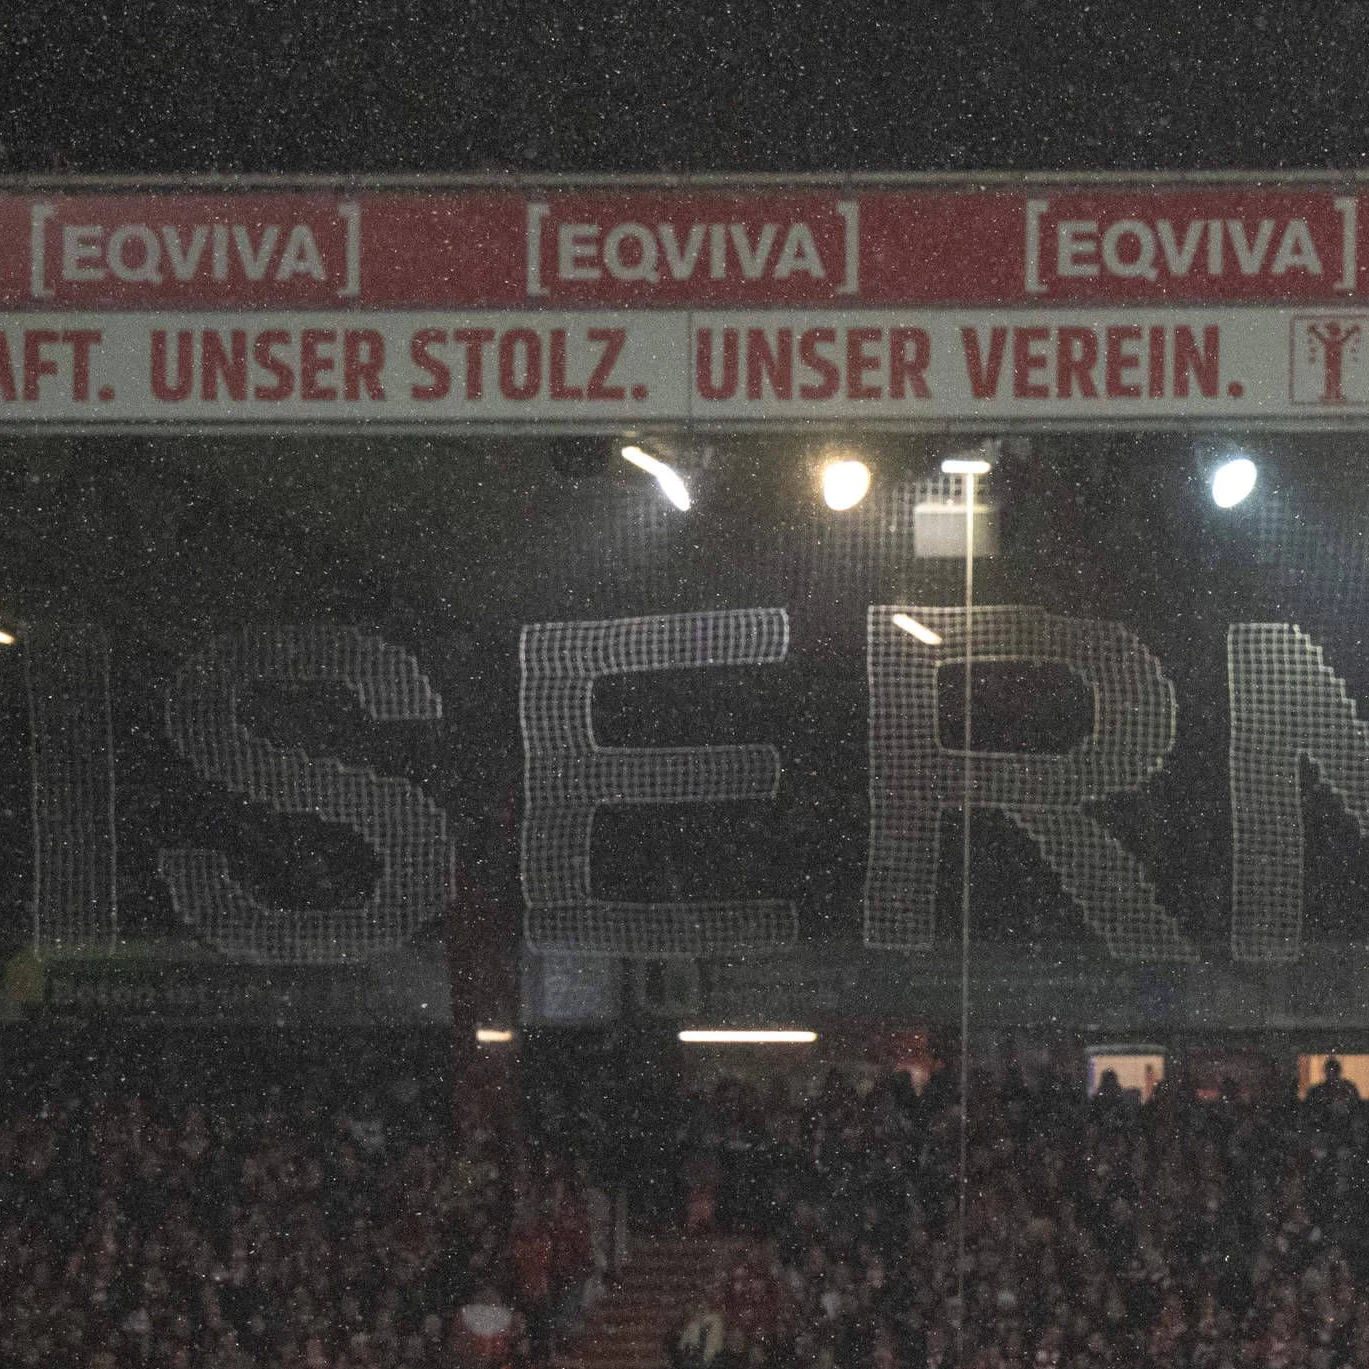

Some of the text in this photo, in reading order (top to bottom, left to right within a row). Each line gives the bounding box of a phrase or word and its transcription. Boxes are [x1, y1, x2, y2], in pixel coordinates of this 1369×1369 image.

[149, 328, 386, 402] UNSER
[410, 328, 648, 402] STOLZ.
[696, 324, 1244, 401] UNSER VEREIN.
